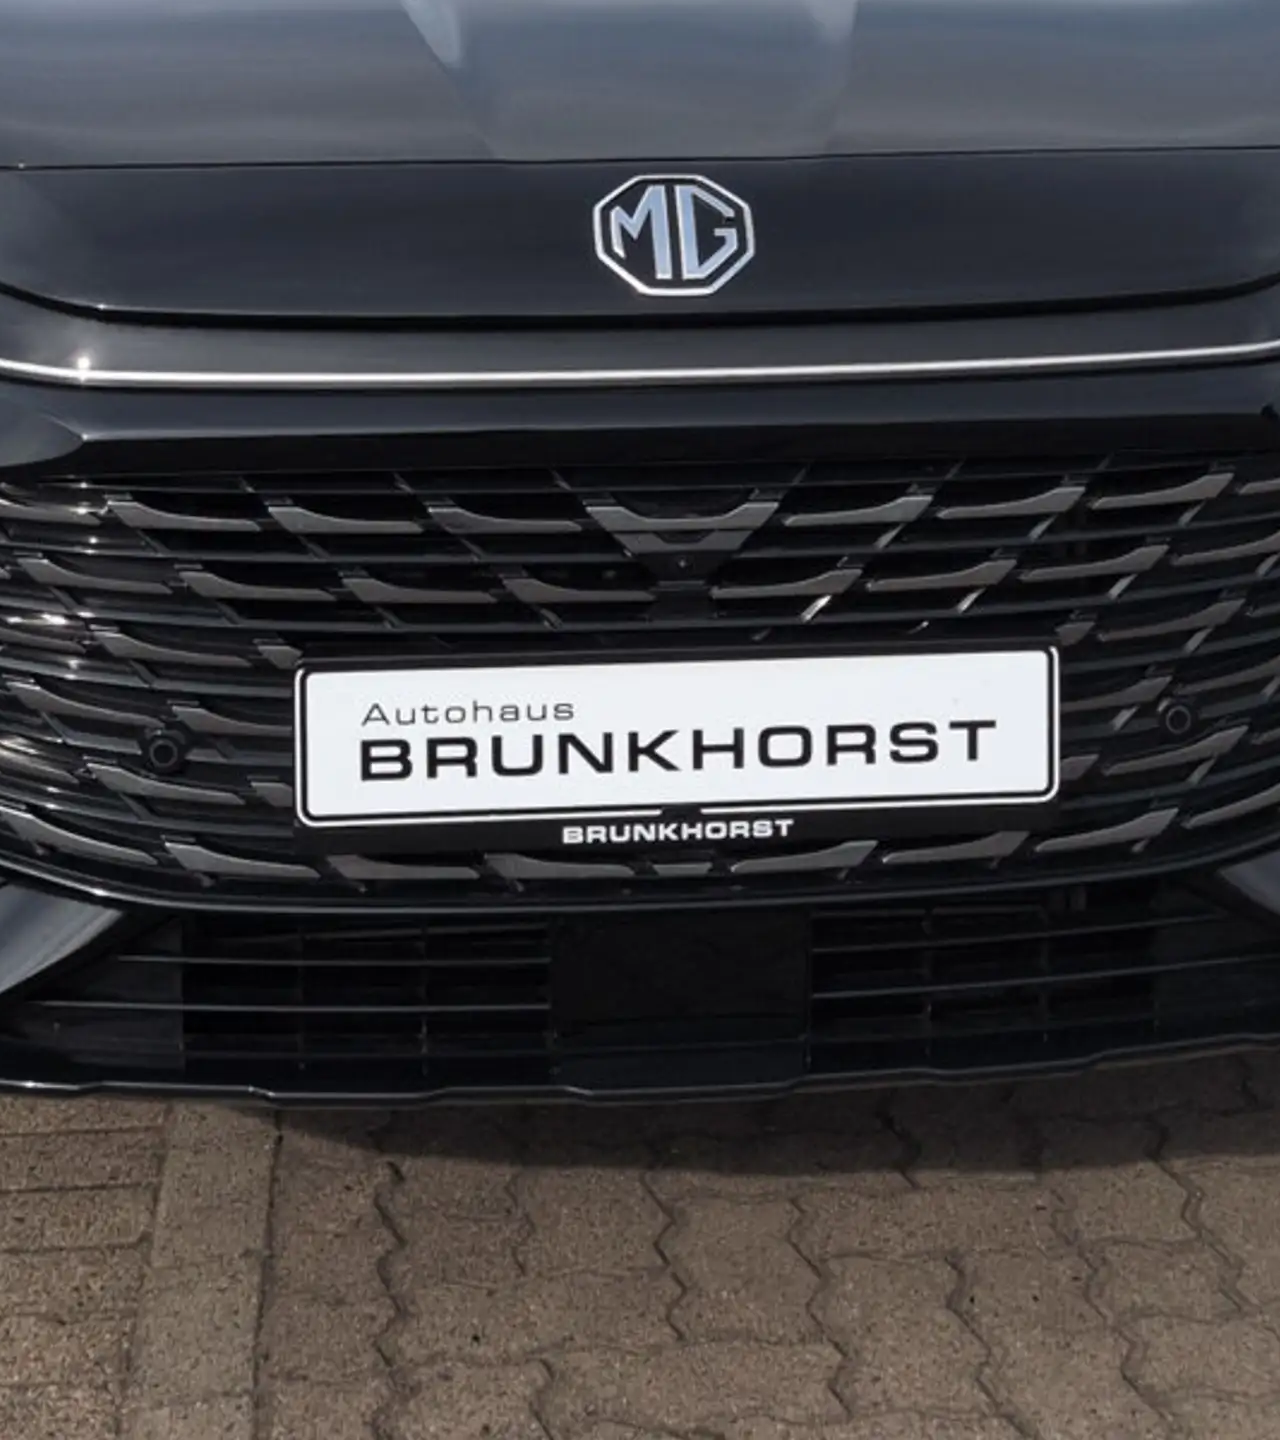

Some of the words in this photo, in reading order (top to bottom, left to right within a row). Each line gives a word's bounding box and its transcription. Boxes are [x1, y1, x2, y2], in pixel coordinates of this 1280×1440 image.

[609, 183, 739, 281] MG
[360, 700, 575, 727] Autohaus
[360, 719, 997, 781] BRUNKHORST
[561, 818, 795, 845] BRUNKHORST
